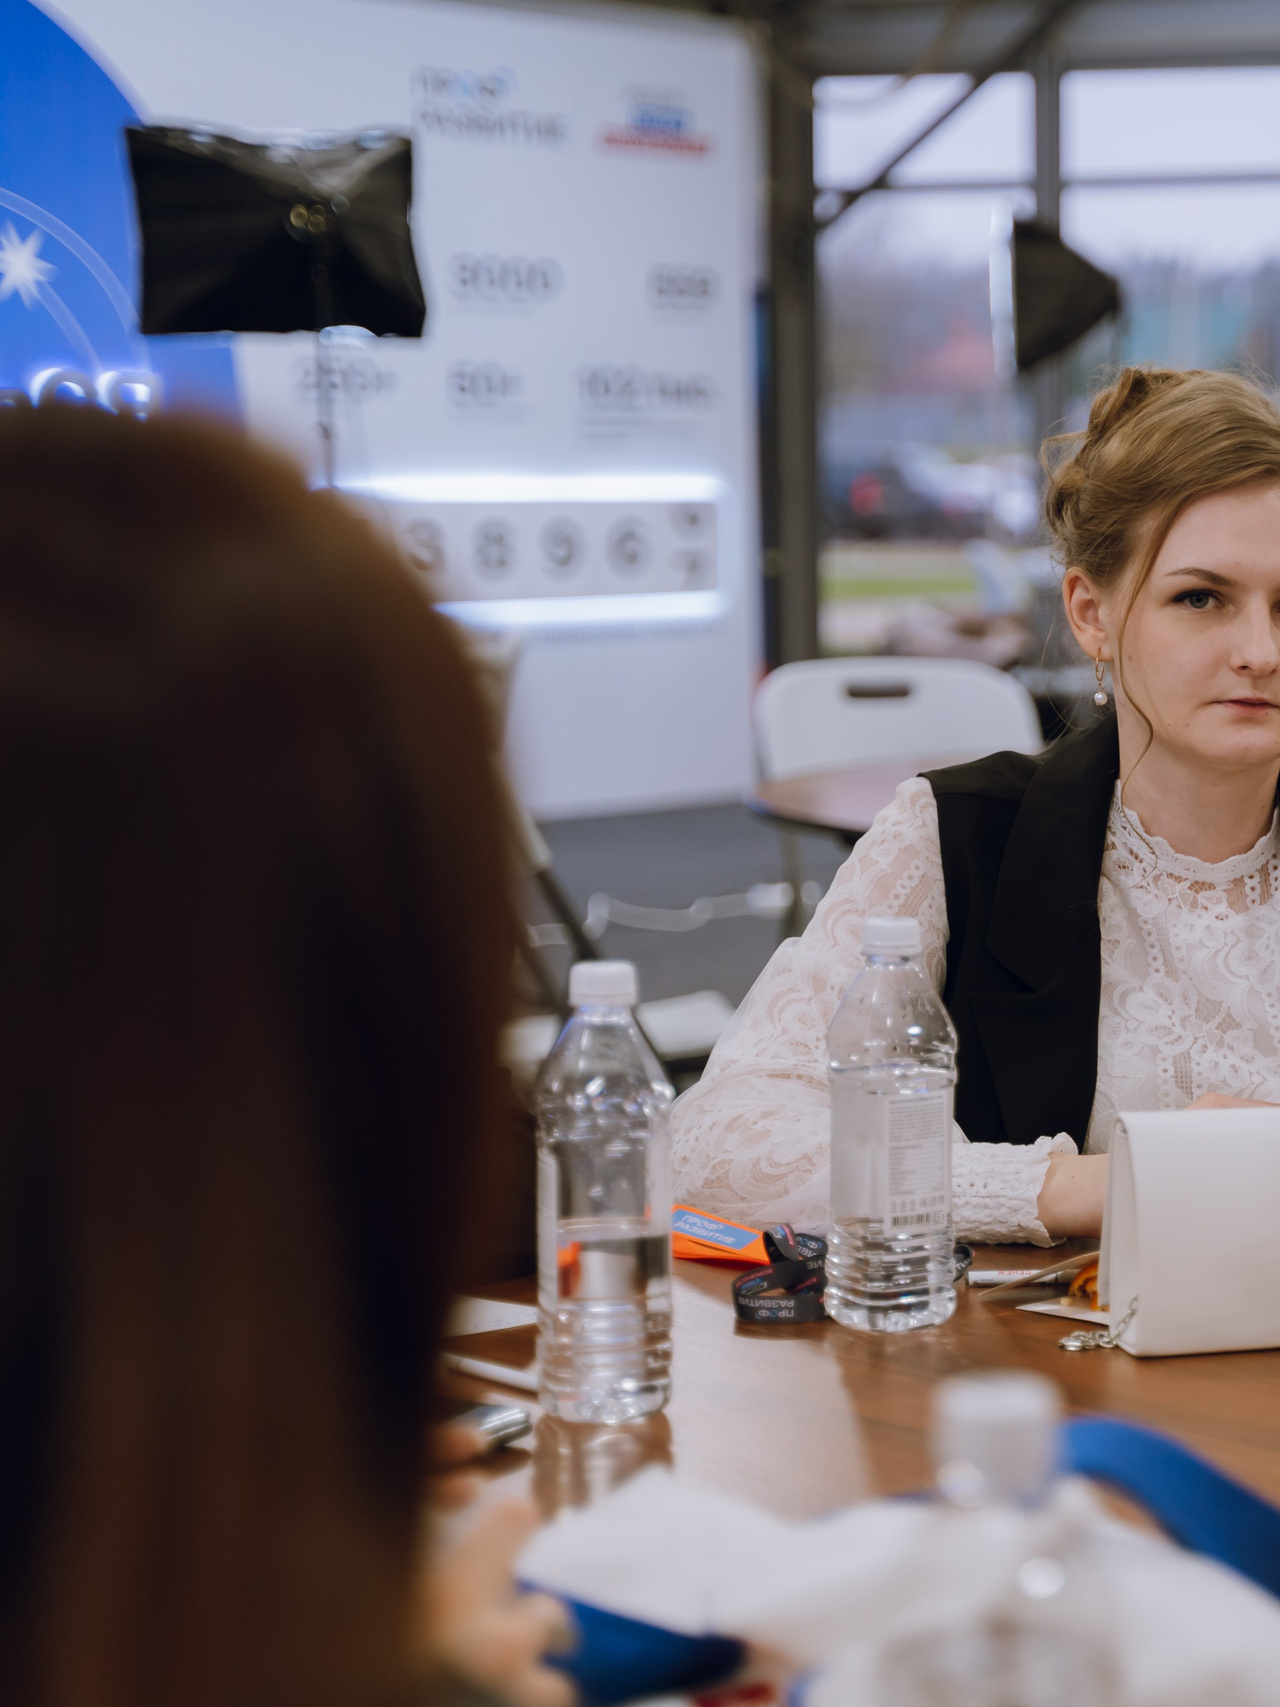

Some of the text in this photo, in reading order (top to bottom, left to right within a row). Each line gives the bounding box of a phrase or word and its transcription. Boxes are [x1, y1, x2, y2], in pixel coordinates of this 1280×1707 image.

[681, 1214, 719, 1230] ПРОФ
[674, 1221, 737, 1244] РАЗВИТИЕ
[738, 1296, 795, 1307] РАЗВИТИЕ
[758, 1309, 795, 1318] ПРОФ
